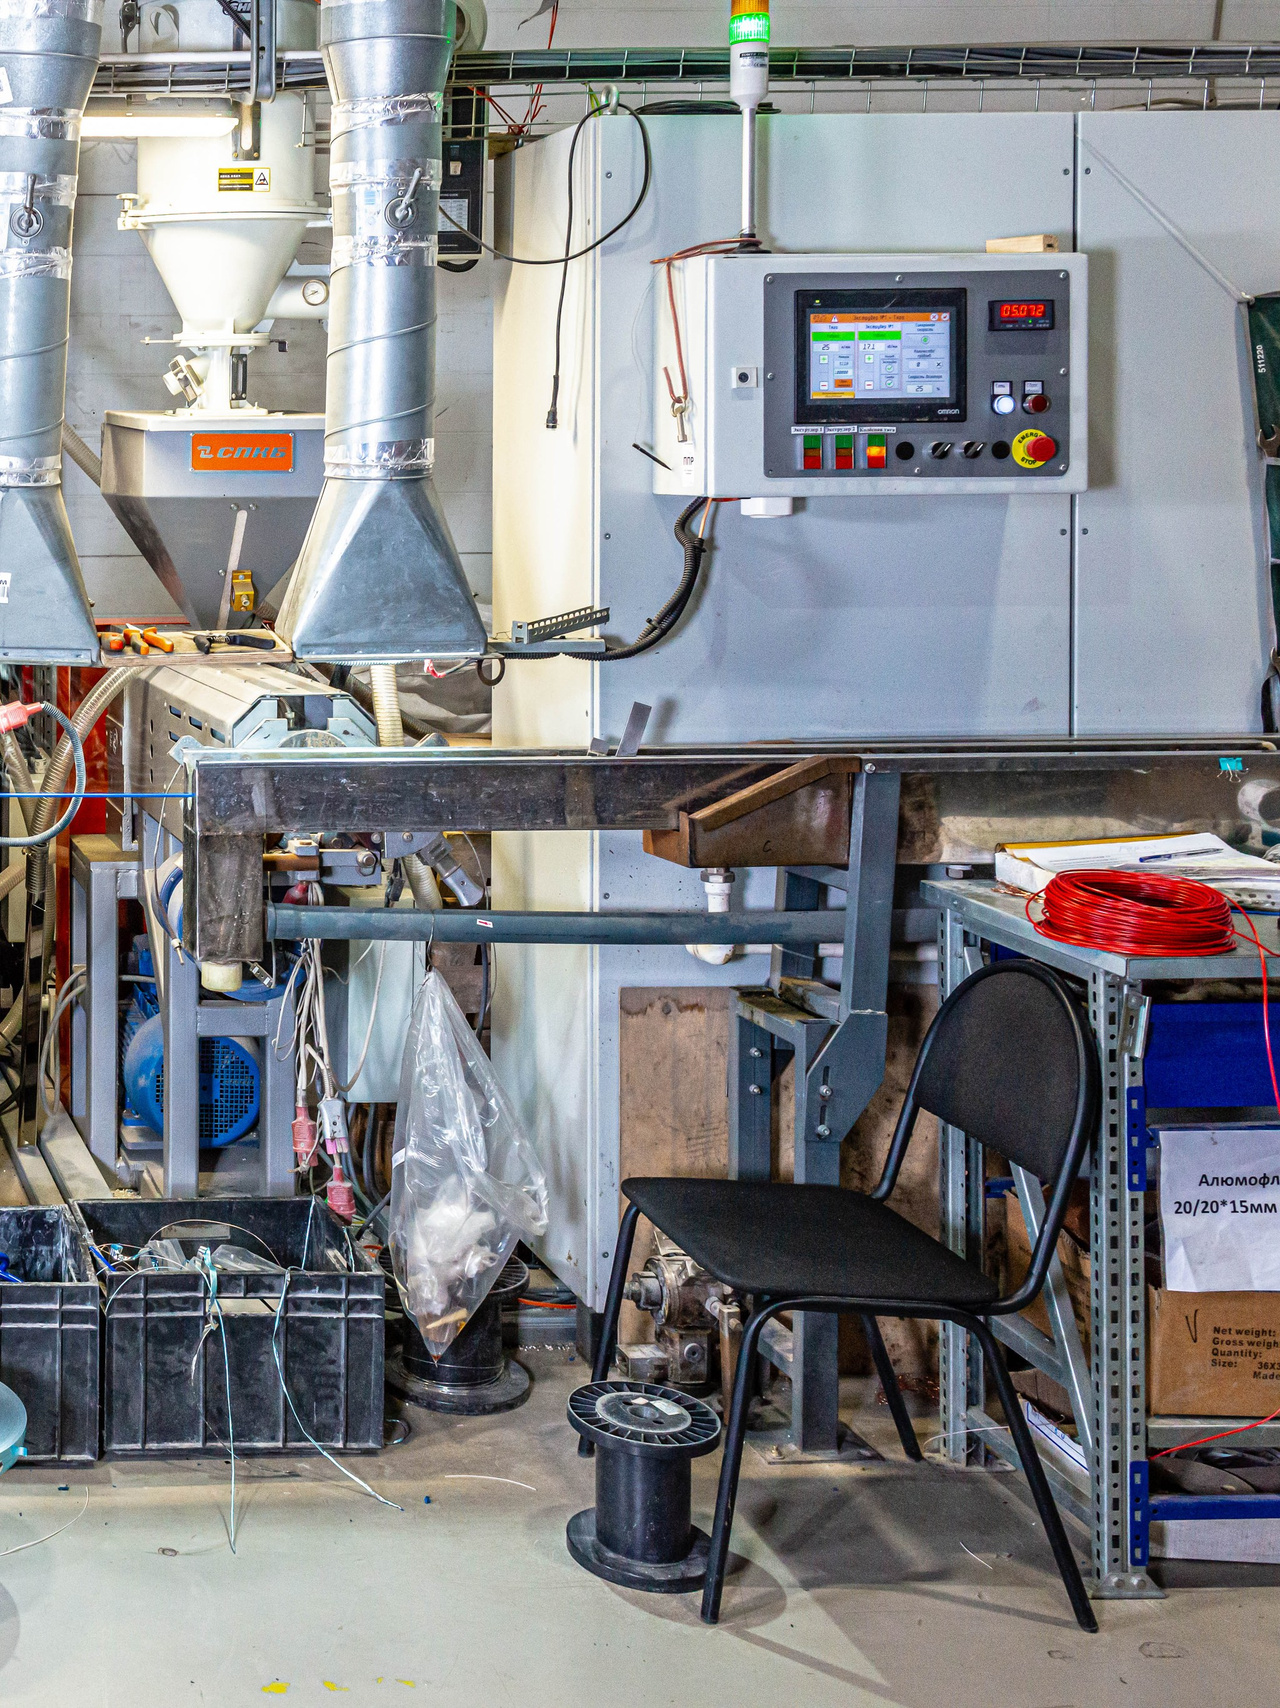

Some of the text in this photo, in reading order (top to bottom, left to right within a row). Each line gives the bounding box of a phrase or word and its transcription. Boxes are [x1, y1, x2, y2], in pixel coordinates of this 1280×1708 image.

[1256, 344, 1266, 373] 511220
[216, 447, 288, 458] СПКБ
[1021, 457, 1037, 465] STOP
[1213, 1326, 1276, 1338] Net weight:
[1212, 1337, 1244, 1346] Gross
[1211, 1347, 1263, 1359] Quantity:
[1211, 1358, 1237, 1368] Size:
